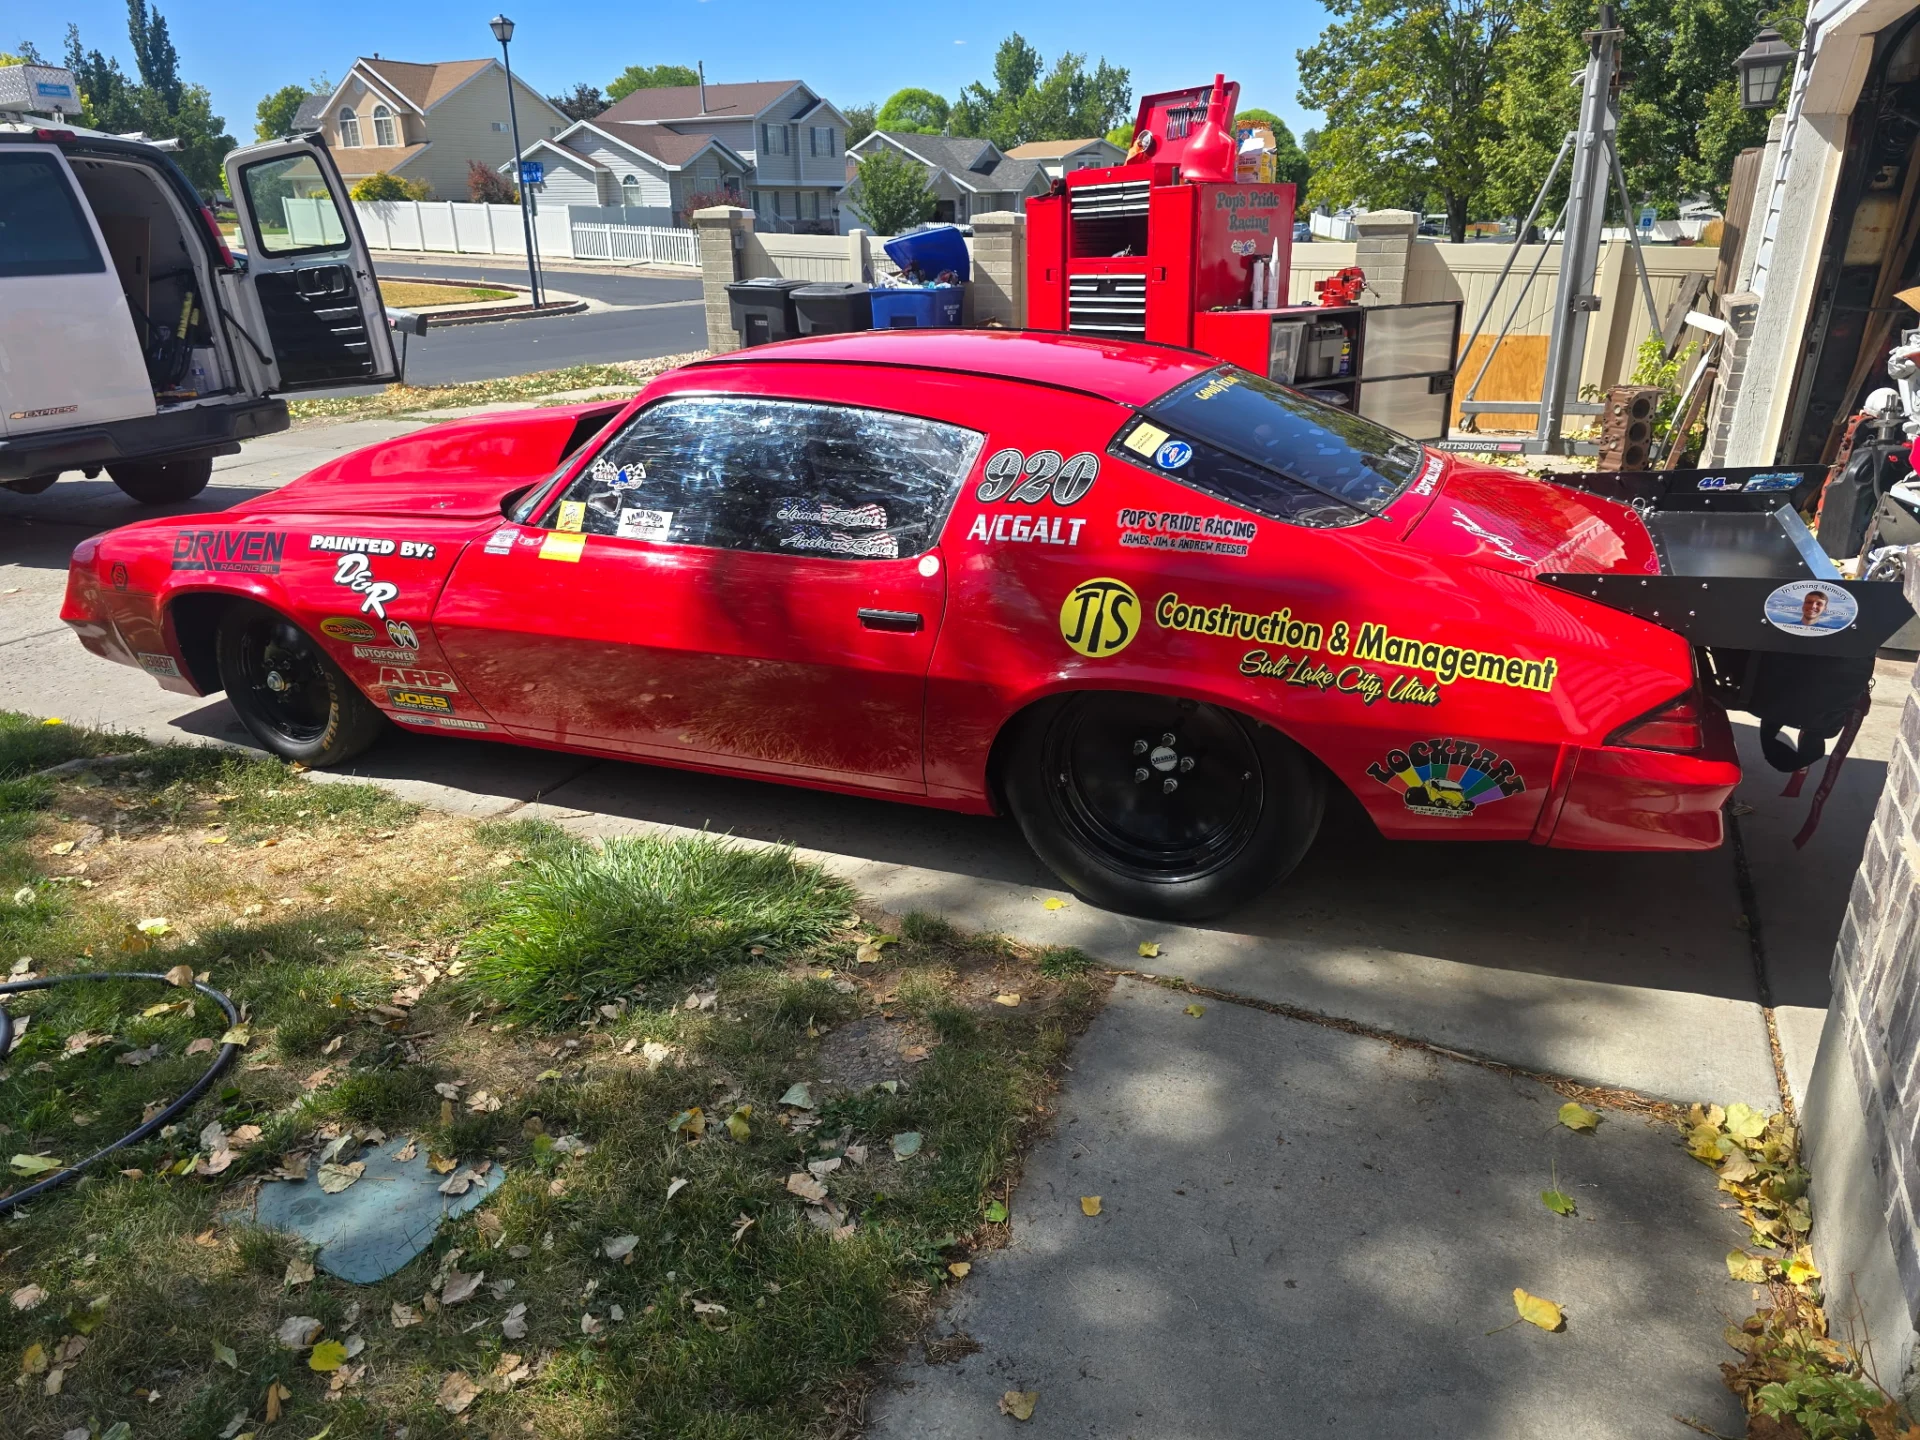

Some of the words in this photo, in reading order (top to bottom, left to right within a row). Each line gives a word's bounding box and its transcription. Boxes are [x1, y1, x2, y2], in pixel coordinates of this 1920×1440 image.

[1216, 191, 1246, 212] Pop's
[1248, 191, 1280, 210] Pride
[1228, 214, 1270, 235] Racing
[25, 405, 78, 418] EXPRESS
[1437, 441, 1498, 451] PITTSBURGH
[976, 448, 1099, 507] 920
[1697, 476, 1727, 488] 44
[776, 504, 825, 521] James
[827, 510, 881, 527] Reeser
[1120, 509, 1157, 528] POP'S
[1160, 513, 1202, 532] PRIDE
[1204, 517, 1256, 539] RACING
[966, 513, 1087, 546] A/CGALT
[173, 530, 287, 566] DRIVEN
[309, 534, 397, 555] PAINTED
[399, 540, 436, 560] BY:
[779, 532, 845, 549] Andrew
[846, 538, 895, 556] Reeser
[1153, 536, 1168, 547] JIM
[1170, 538, 1176, 547] &
[1178, 538, 1214, 552] ANDREW
[1215, 542, 1248, 555] REESER
[220, 563, 259, 572] RACING
[260, 564, 277, 573] OIL
[1821, 584, 1849, 601] Memory
[1157, 593, 1322, 649] Construction
[1330, 622, 1348, 654] &
[1354, 623, 1557, 691] Management
[354, 645, 416, 662] AUTOPOWER
[380, 667, 457, 691] ARP
[1239, 649, 1292, 679] Salt
[1286, 655, 1335, 690] Lake
[1387, 675, 1439, 706] Utah
[394, 692, 448, 708] JOES
[440, 718, 486, 730] MOROSO
[1365, 738, 1527, 798] LOCKHART
